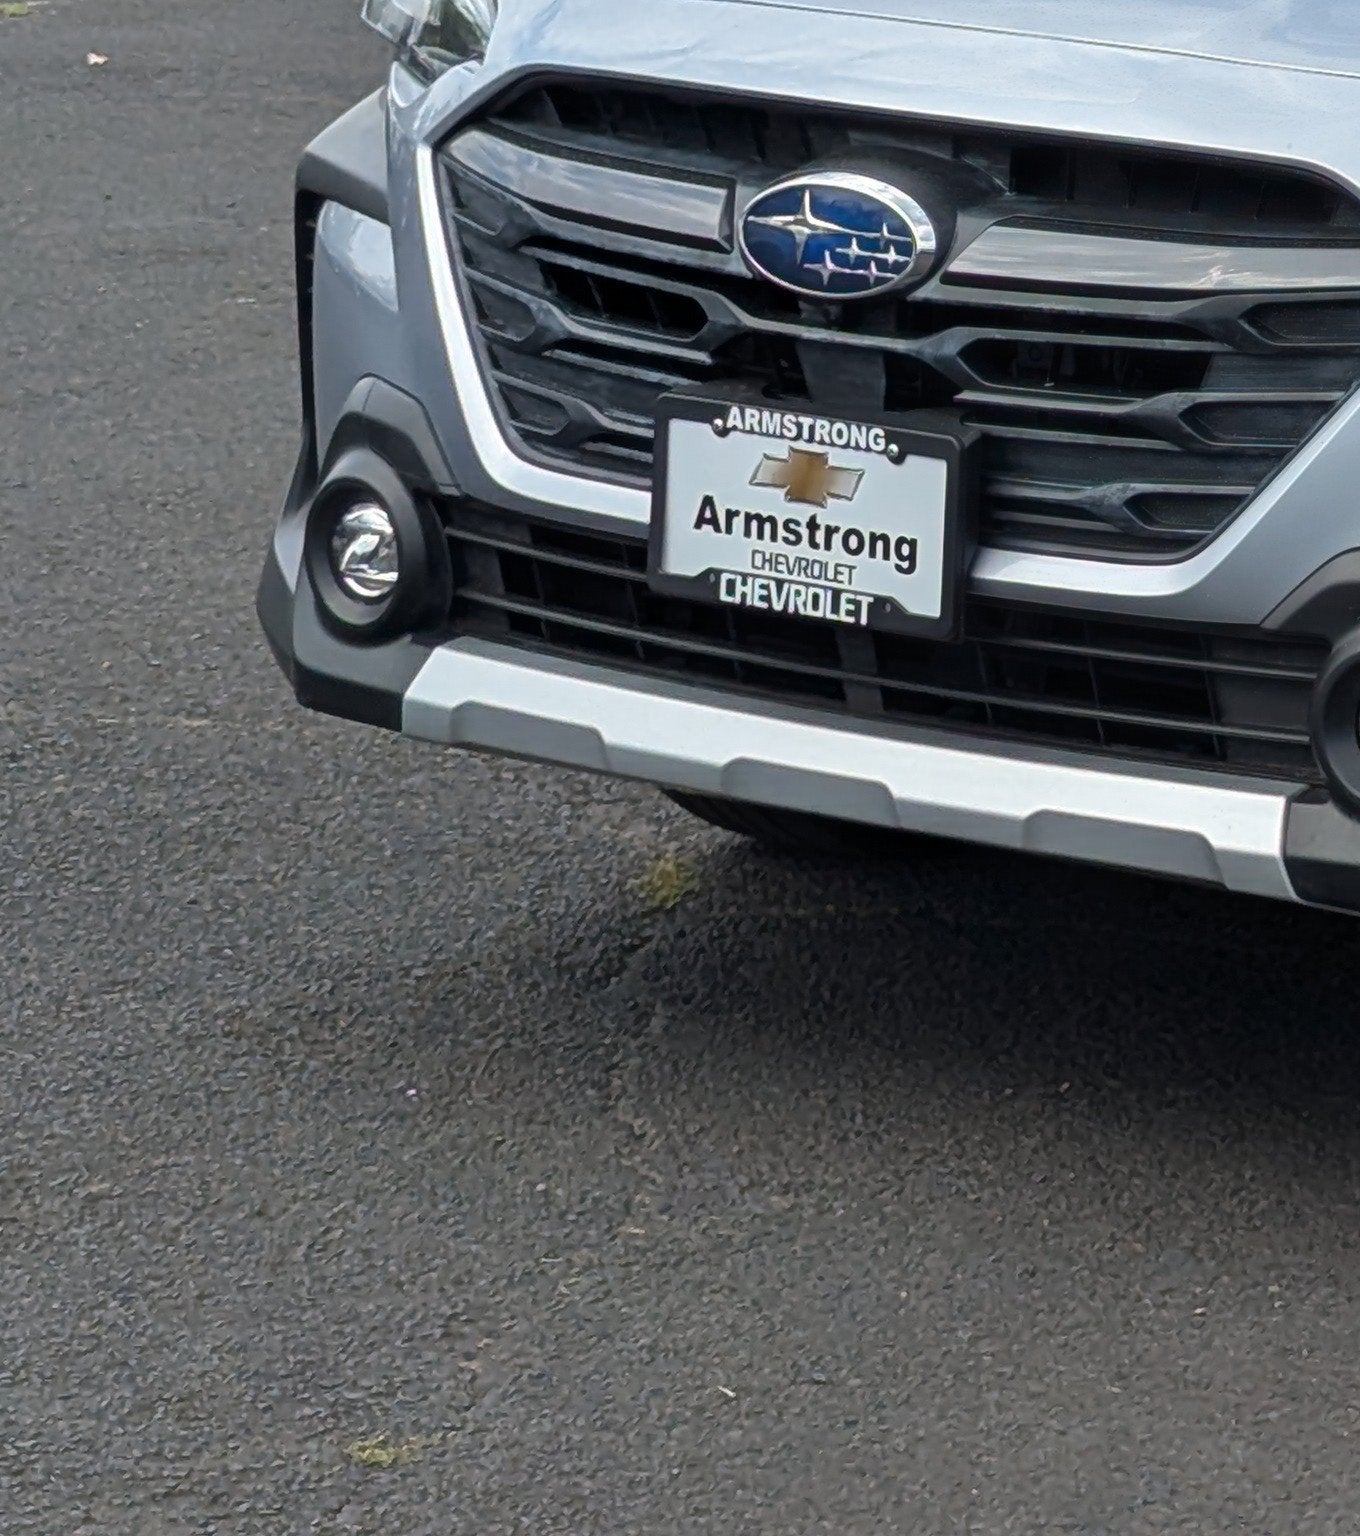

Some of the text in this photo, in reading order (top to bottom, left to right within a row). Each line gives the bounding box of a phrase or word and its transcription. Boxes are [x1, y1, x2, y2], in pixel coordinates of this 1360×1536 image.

[726, 405, 887, 453] ARMSTRONG
[693, 493, 919, 576] Armstrong
[751, 548, 858, 587] CHEVROLET
[719, 573, 876, 627] CHEVROLET
